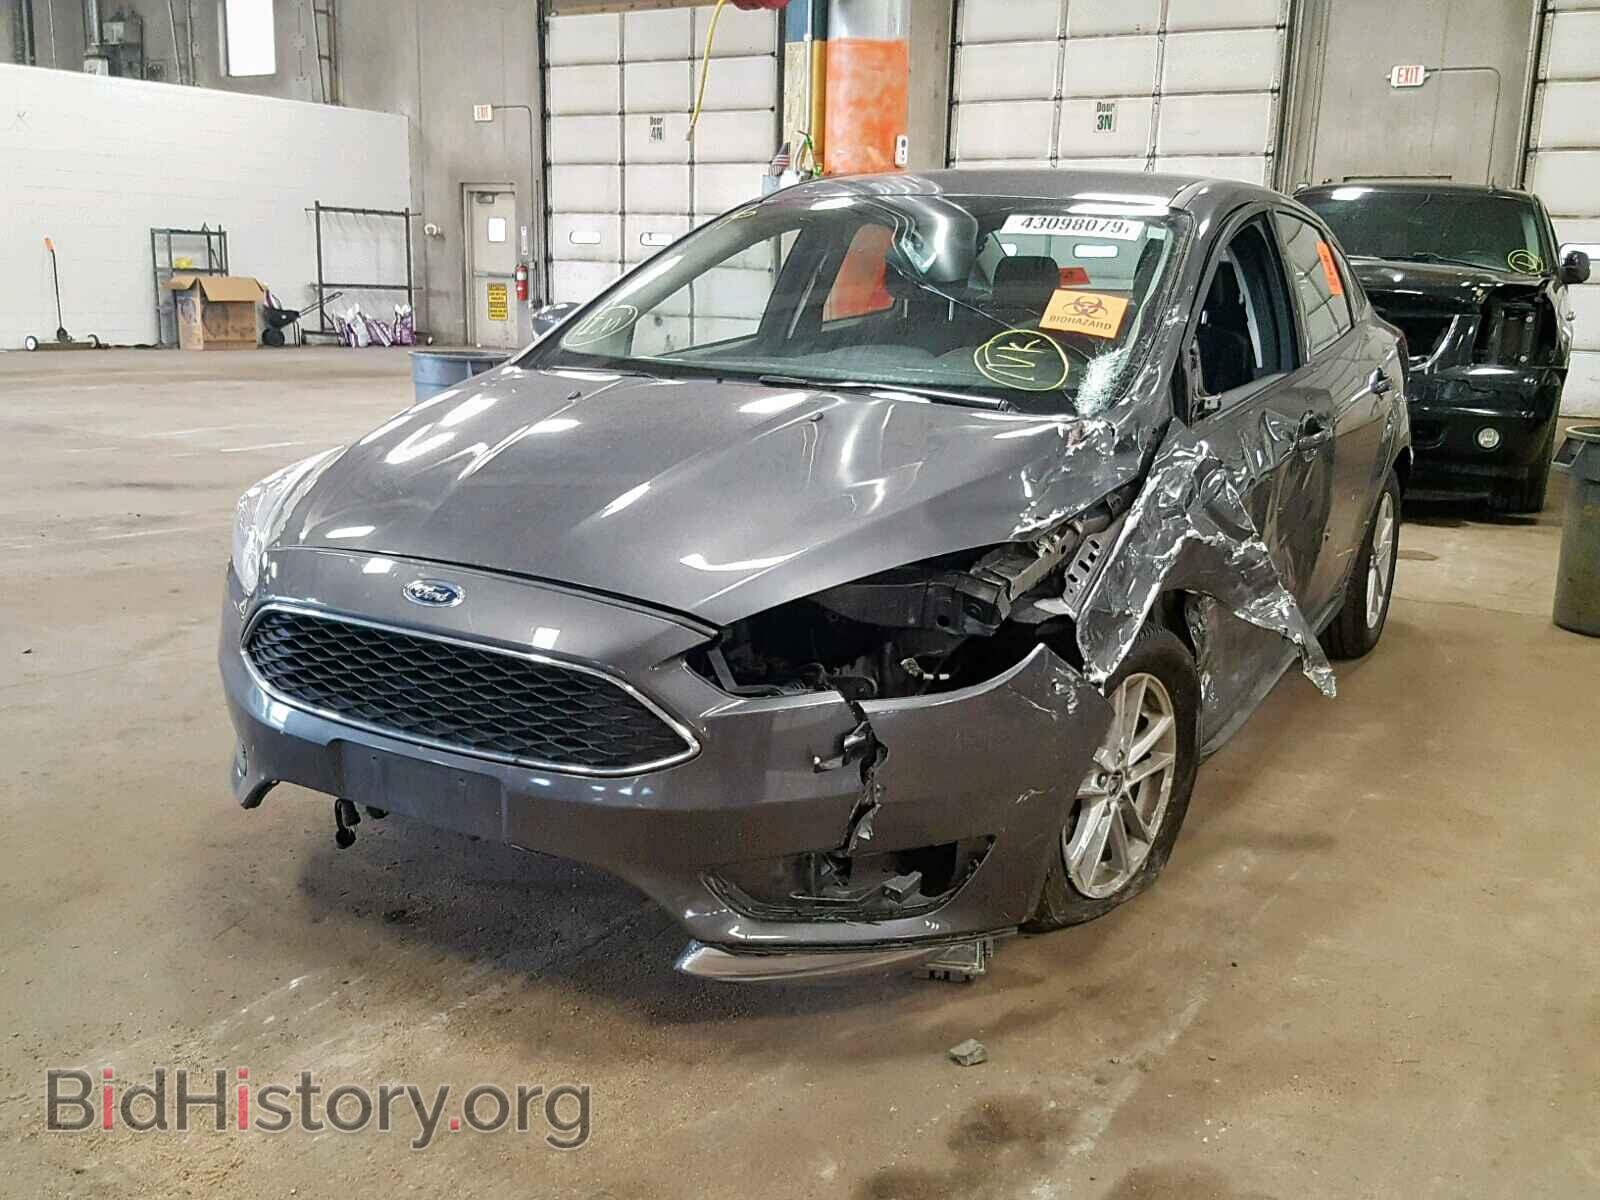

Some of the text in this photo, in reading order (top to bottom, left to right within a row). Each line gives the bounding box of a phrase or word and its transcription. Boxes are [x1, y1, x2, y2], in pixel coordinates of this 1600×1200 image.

[1397, 67, 1421, 85] EXIT
[1096, 102, 1115, 113] Door
[1097, 114, 1113, 131] 3N
[1049, 315, 1112, 331] BIOHAZARD
